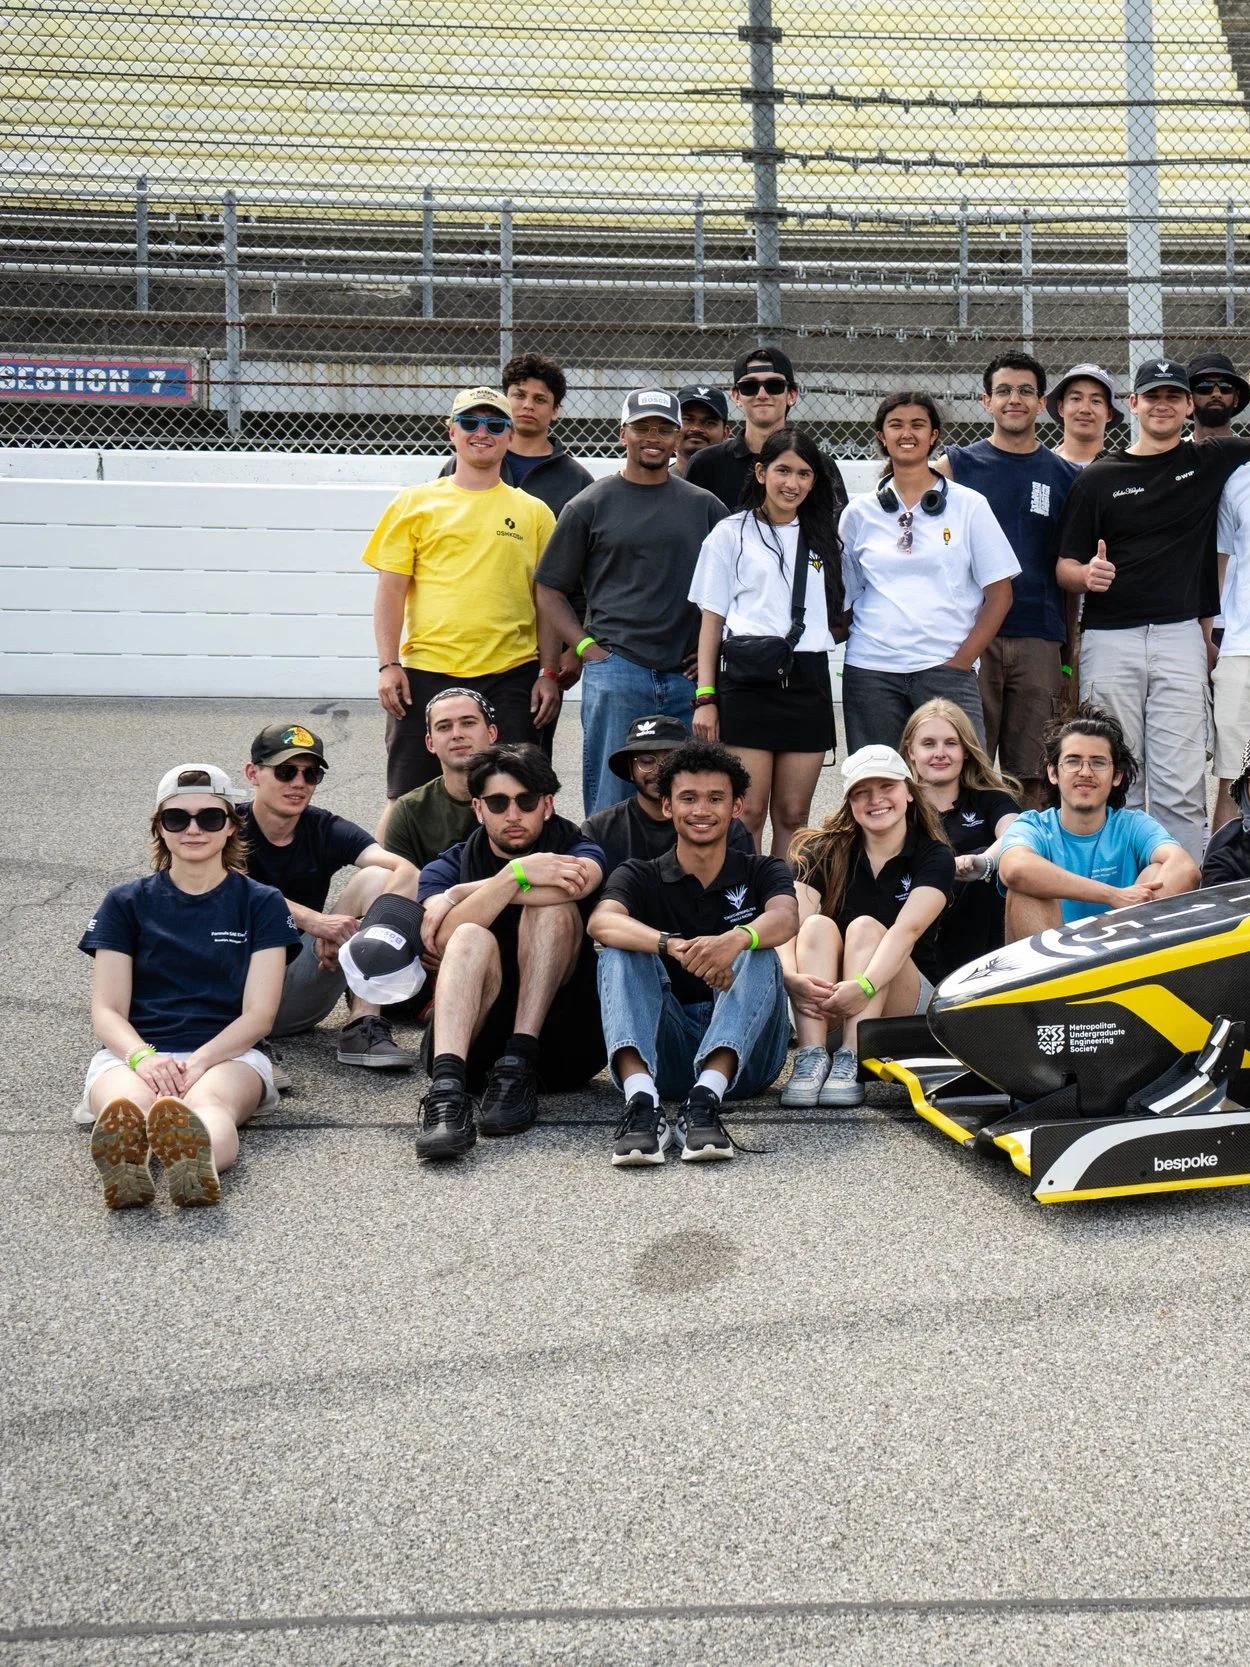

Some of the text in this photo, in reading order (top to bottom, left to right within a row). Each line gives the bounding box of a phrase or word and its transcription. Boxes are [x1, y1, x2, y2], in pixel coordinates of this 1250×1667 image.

[0, 366, 166, 394] SECTION 7
[496, 530, 524, 540] OSHKOSH
[1069, 1022, 1116, 1031] Metropolitan
[1069, 1029, 1125, 1038] Undergraduate
[1069, 1037, 1114, 1047] Engineering
[1154, 1152, 1218, 1172] bespoke
